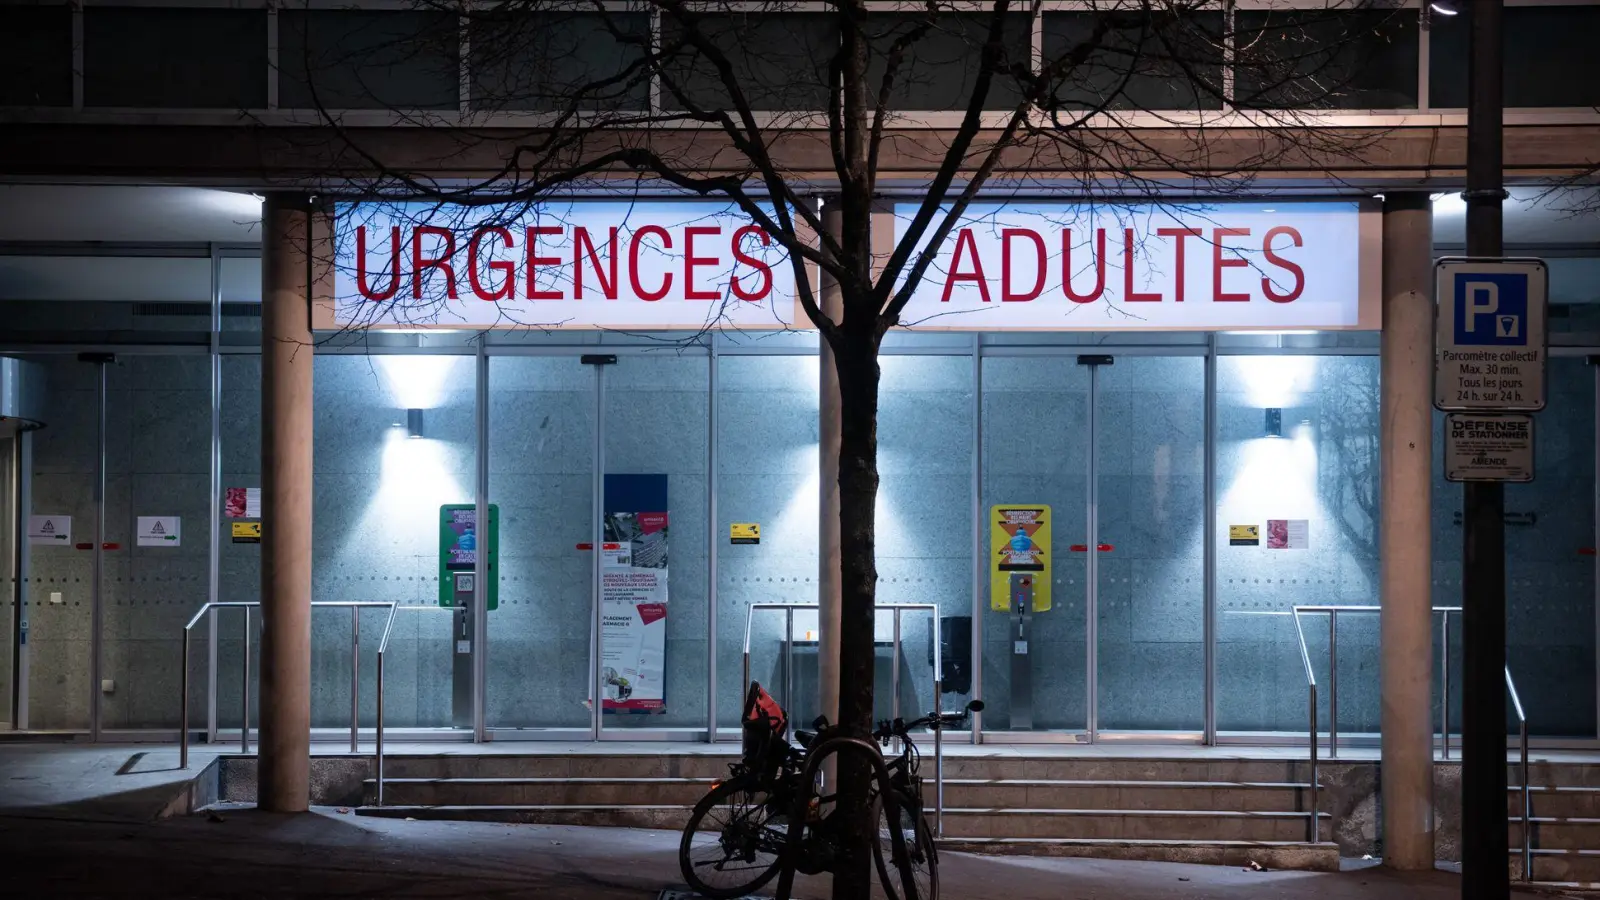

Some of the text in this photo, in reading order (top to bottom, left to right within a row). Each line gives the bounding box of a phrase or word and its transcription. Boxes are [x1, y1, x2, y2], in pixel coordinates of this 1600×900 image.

[355, 224, 1305, 304] URGENCES ADULTES
[1464, 281, 1499, 332] P
[1443, 350, 1538, 361] Parcomètre collectif
[1459, 364, 1521, 375] Max. 30 min.
[1458, 377, 1523, 390] Tous les jours
[1457, 390, 1524, 401] 24 h. sur 24 h.
[1452, 430, 1529, 439] DE STATIONNER
[1471, 457, 1508, 466] AMENDE
